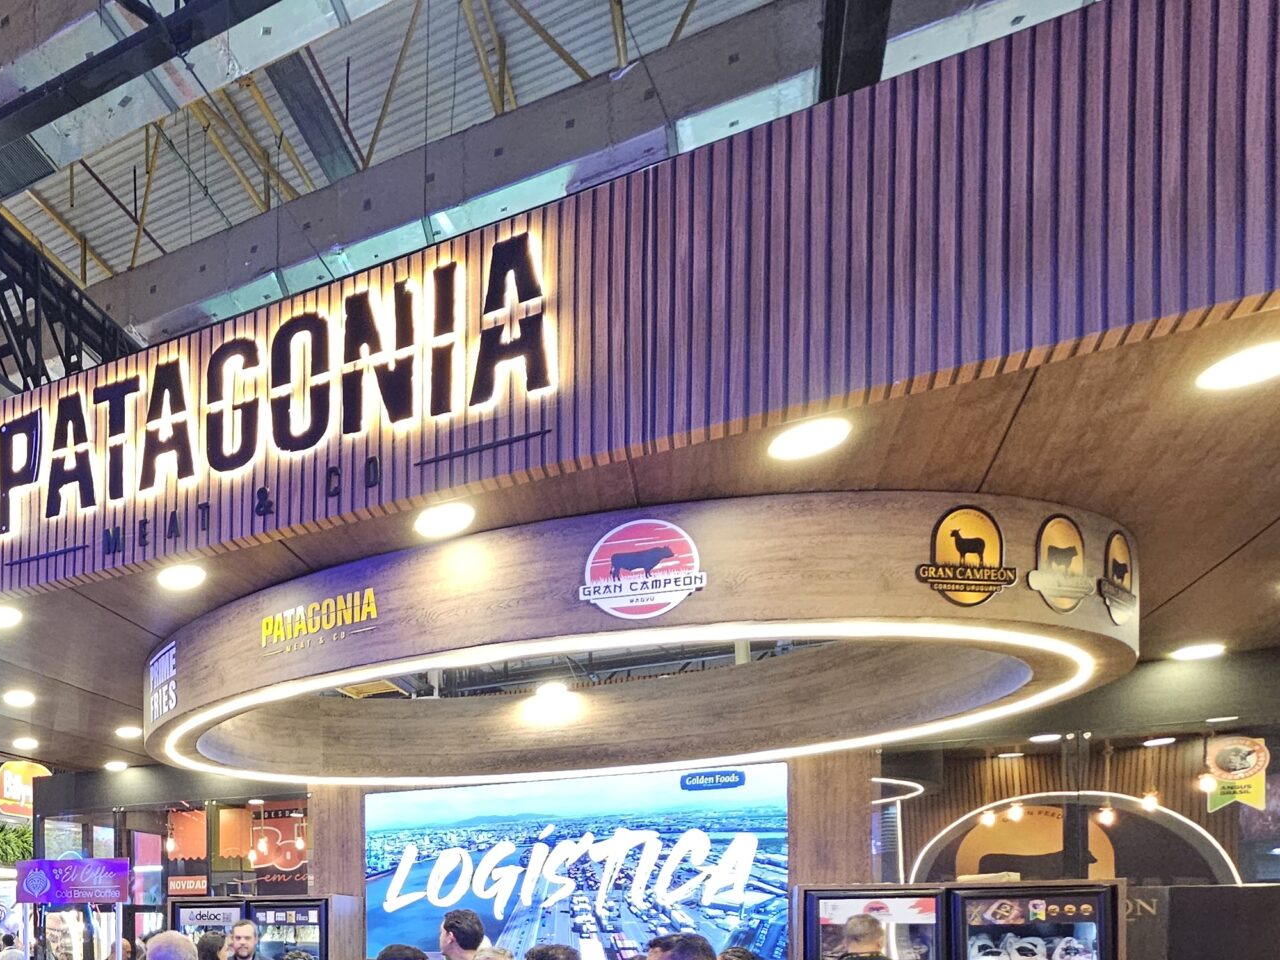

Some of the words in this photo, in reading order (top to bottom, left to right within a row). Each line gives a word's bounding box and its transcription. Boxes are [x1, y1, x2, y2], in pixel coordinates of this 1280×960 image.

[104, 500, 210, 555] MEAT
[255, 486, 274, 516] &
[919, 565, 954, 578] GRAN
[581, 583, 623, 598] GRAN
[933, 583, 965, 591] CORDERO
[261, 587, 379, 649] PATAGONIA
[285, 639, 313, 654] MEAT
[149, 645, 178, 694] PRIME
[149, 680, 178, 725] FRIES
[685, 774, 715, 786] Golden
[715, 773, 740, 784] Foods
[62, 865, 78, 883] El
[80, 864, 117, 885] Coffee
[382, 823, 759, 921] LOGÍSTICA
[169, 880, 208, 890] NOVIDAD
[55, 889, 73, 899] Cold
[73, 889, 93, 898] Brew
[94, 889, 121, 898] Coffee
[195, 911, 221, 921] deloc
